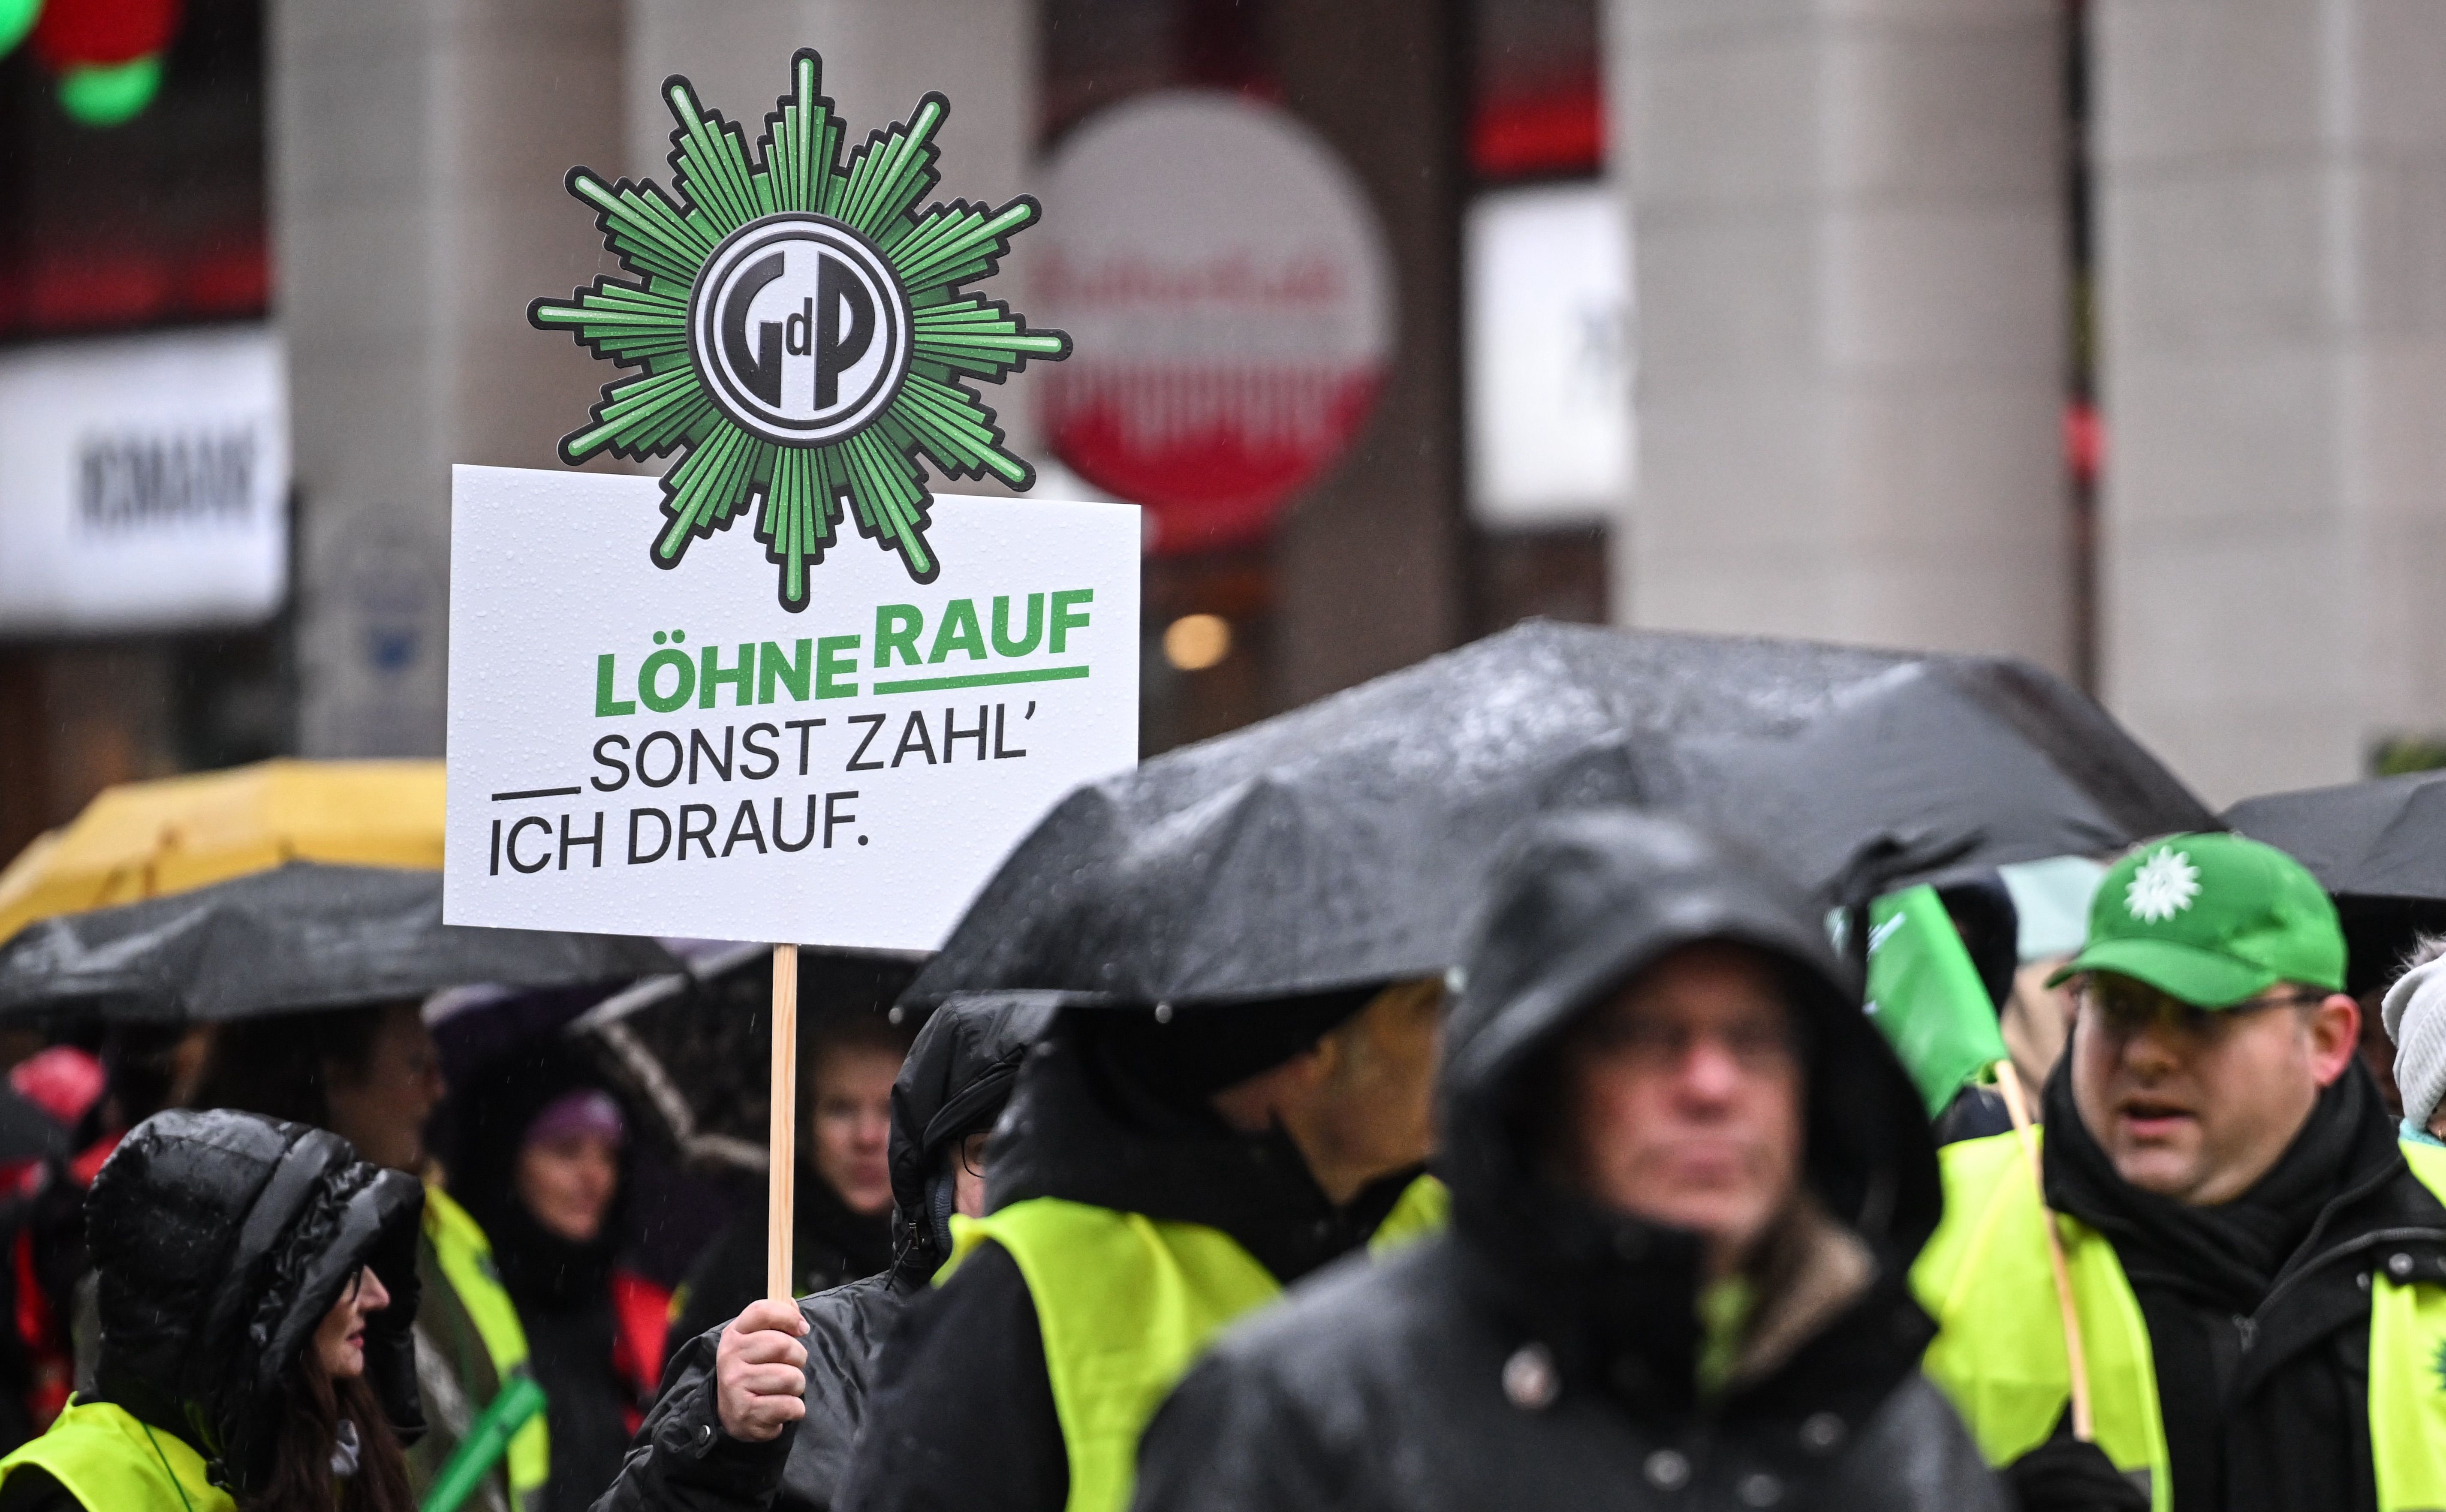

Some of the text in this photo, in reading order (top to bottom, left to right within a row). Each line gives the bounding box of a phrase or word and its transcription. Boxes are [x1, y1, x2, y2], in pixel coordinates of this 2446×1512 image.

[721, 250, 876, 411] GdP
[595, 589, 1093, 717] LÖHNE RAUF
[590, 718, 827, 792] SONST
[489, 790, 869, 876] ICH DRAUF.
